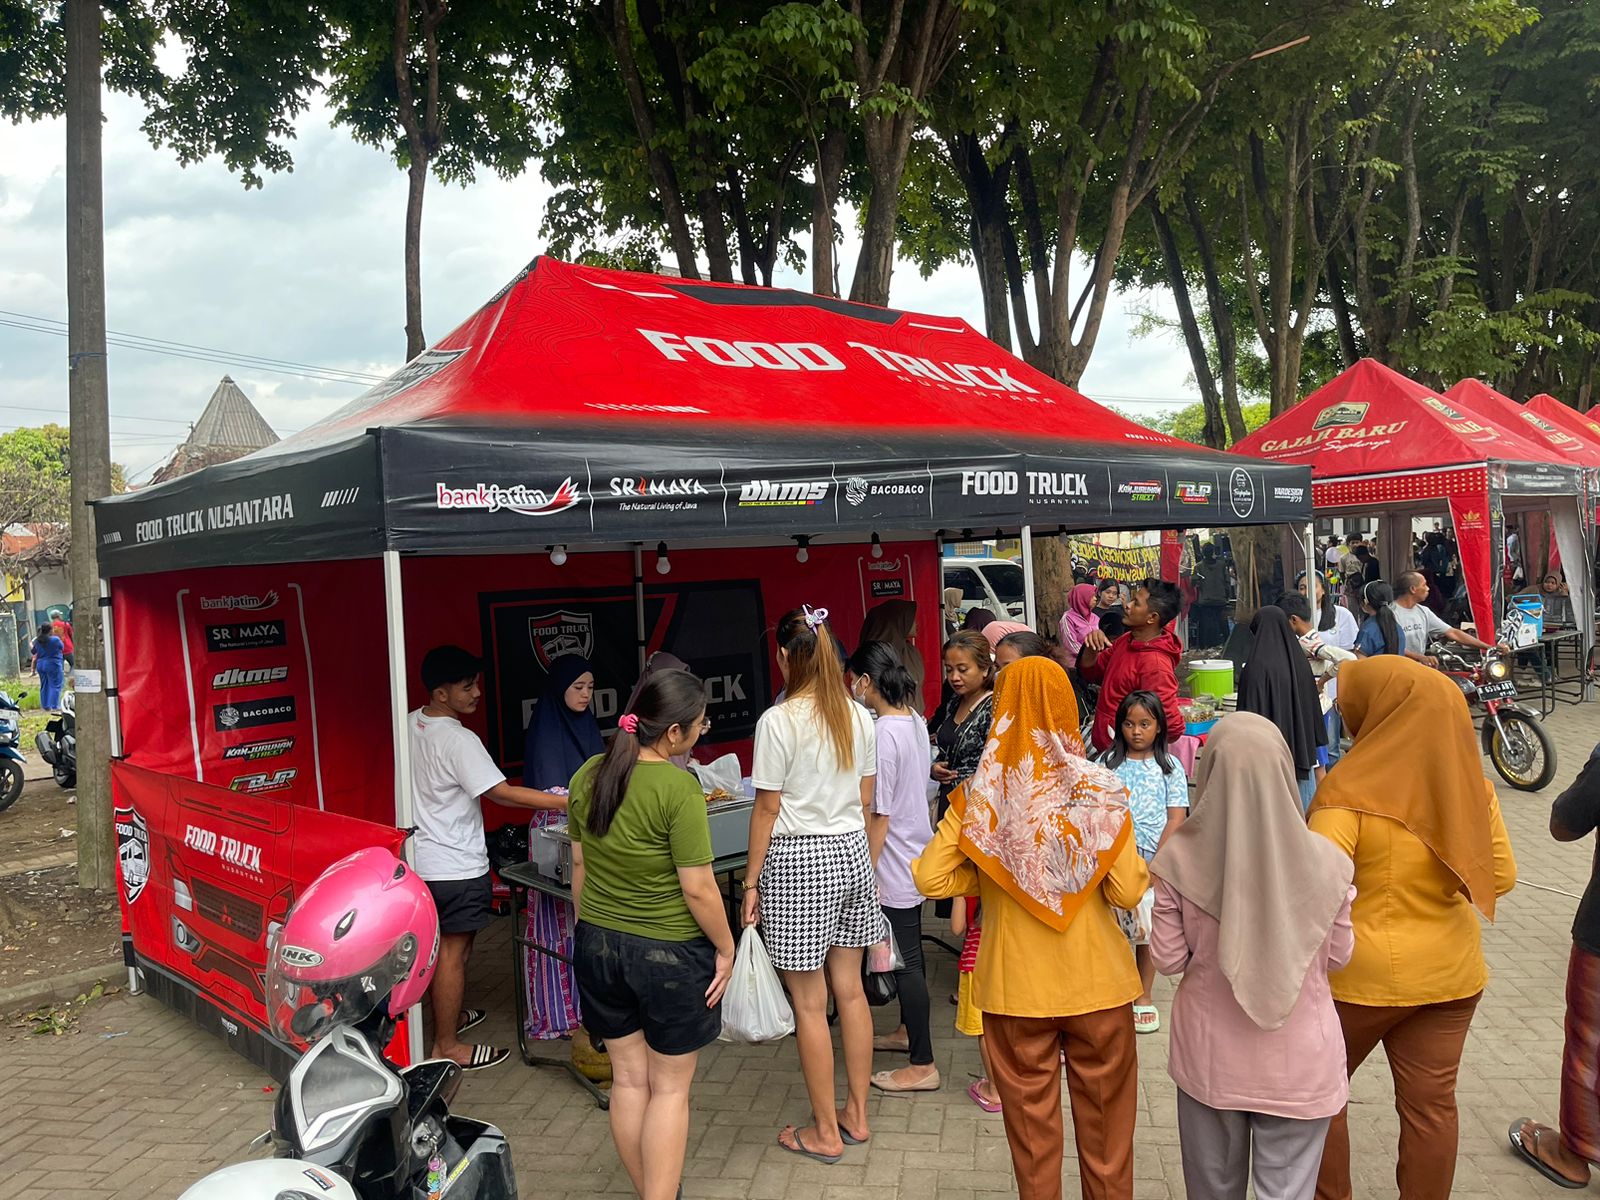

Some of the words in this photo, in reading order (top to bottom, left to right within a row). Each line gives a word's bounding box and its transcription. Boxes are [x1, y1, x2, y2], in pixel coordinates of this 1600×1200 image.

[635, 328, 847, 371] FOOD
[846, 341, 1042, 394] TRUCK
[897, 375, 1057, 404] NUSANTARA
[1260, 428, 1334, 453] GAJAH
[1334, 420, 1409, 440] BARU
[870, 484, 925, 495] BACOBACO
[961, 471, 1018, 495] FOOD
[1026, 472, 1088, 496] TRUCK
[436, 482, 549, 513] bankjatim
[619, 502, 631, 511] The
[631, 502, 657, 510] Natural
[657, 502, 675, 512] Living
[675, 502, 683, 510] of
[136, 518, 164, 543] FOOD
[166, 509, 204, 537] TRUCK
[207, 493, 294, 531] NUSANTARA
[200, 595, 260, 611] bankjatim
[533, 626, 559, 636] FOOD
[560, 624, 590, 634] TRUCK
[213, 666, 288, 687] dkms
[242, 705, 292, 718] BACOBACO
[521, 688, 618, 731] FD
[116, 823, 133, 837] FOOD
[184, 824, 216, 856] FOOD
[219, 835, 262, 874] TRUCK
[282, 948, 316, 963] INK
